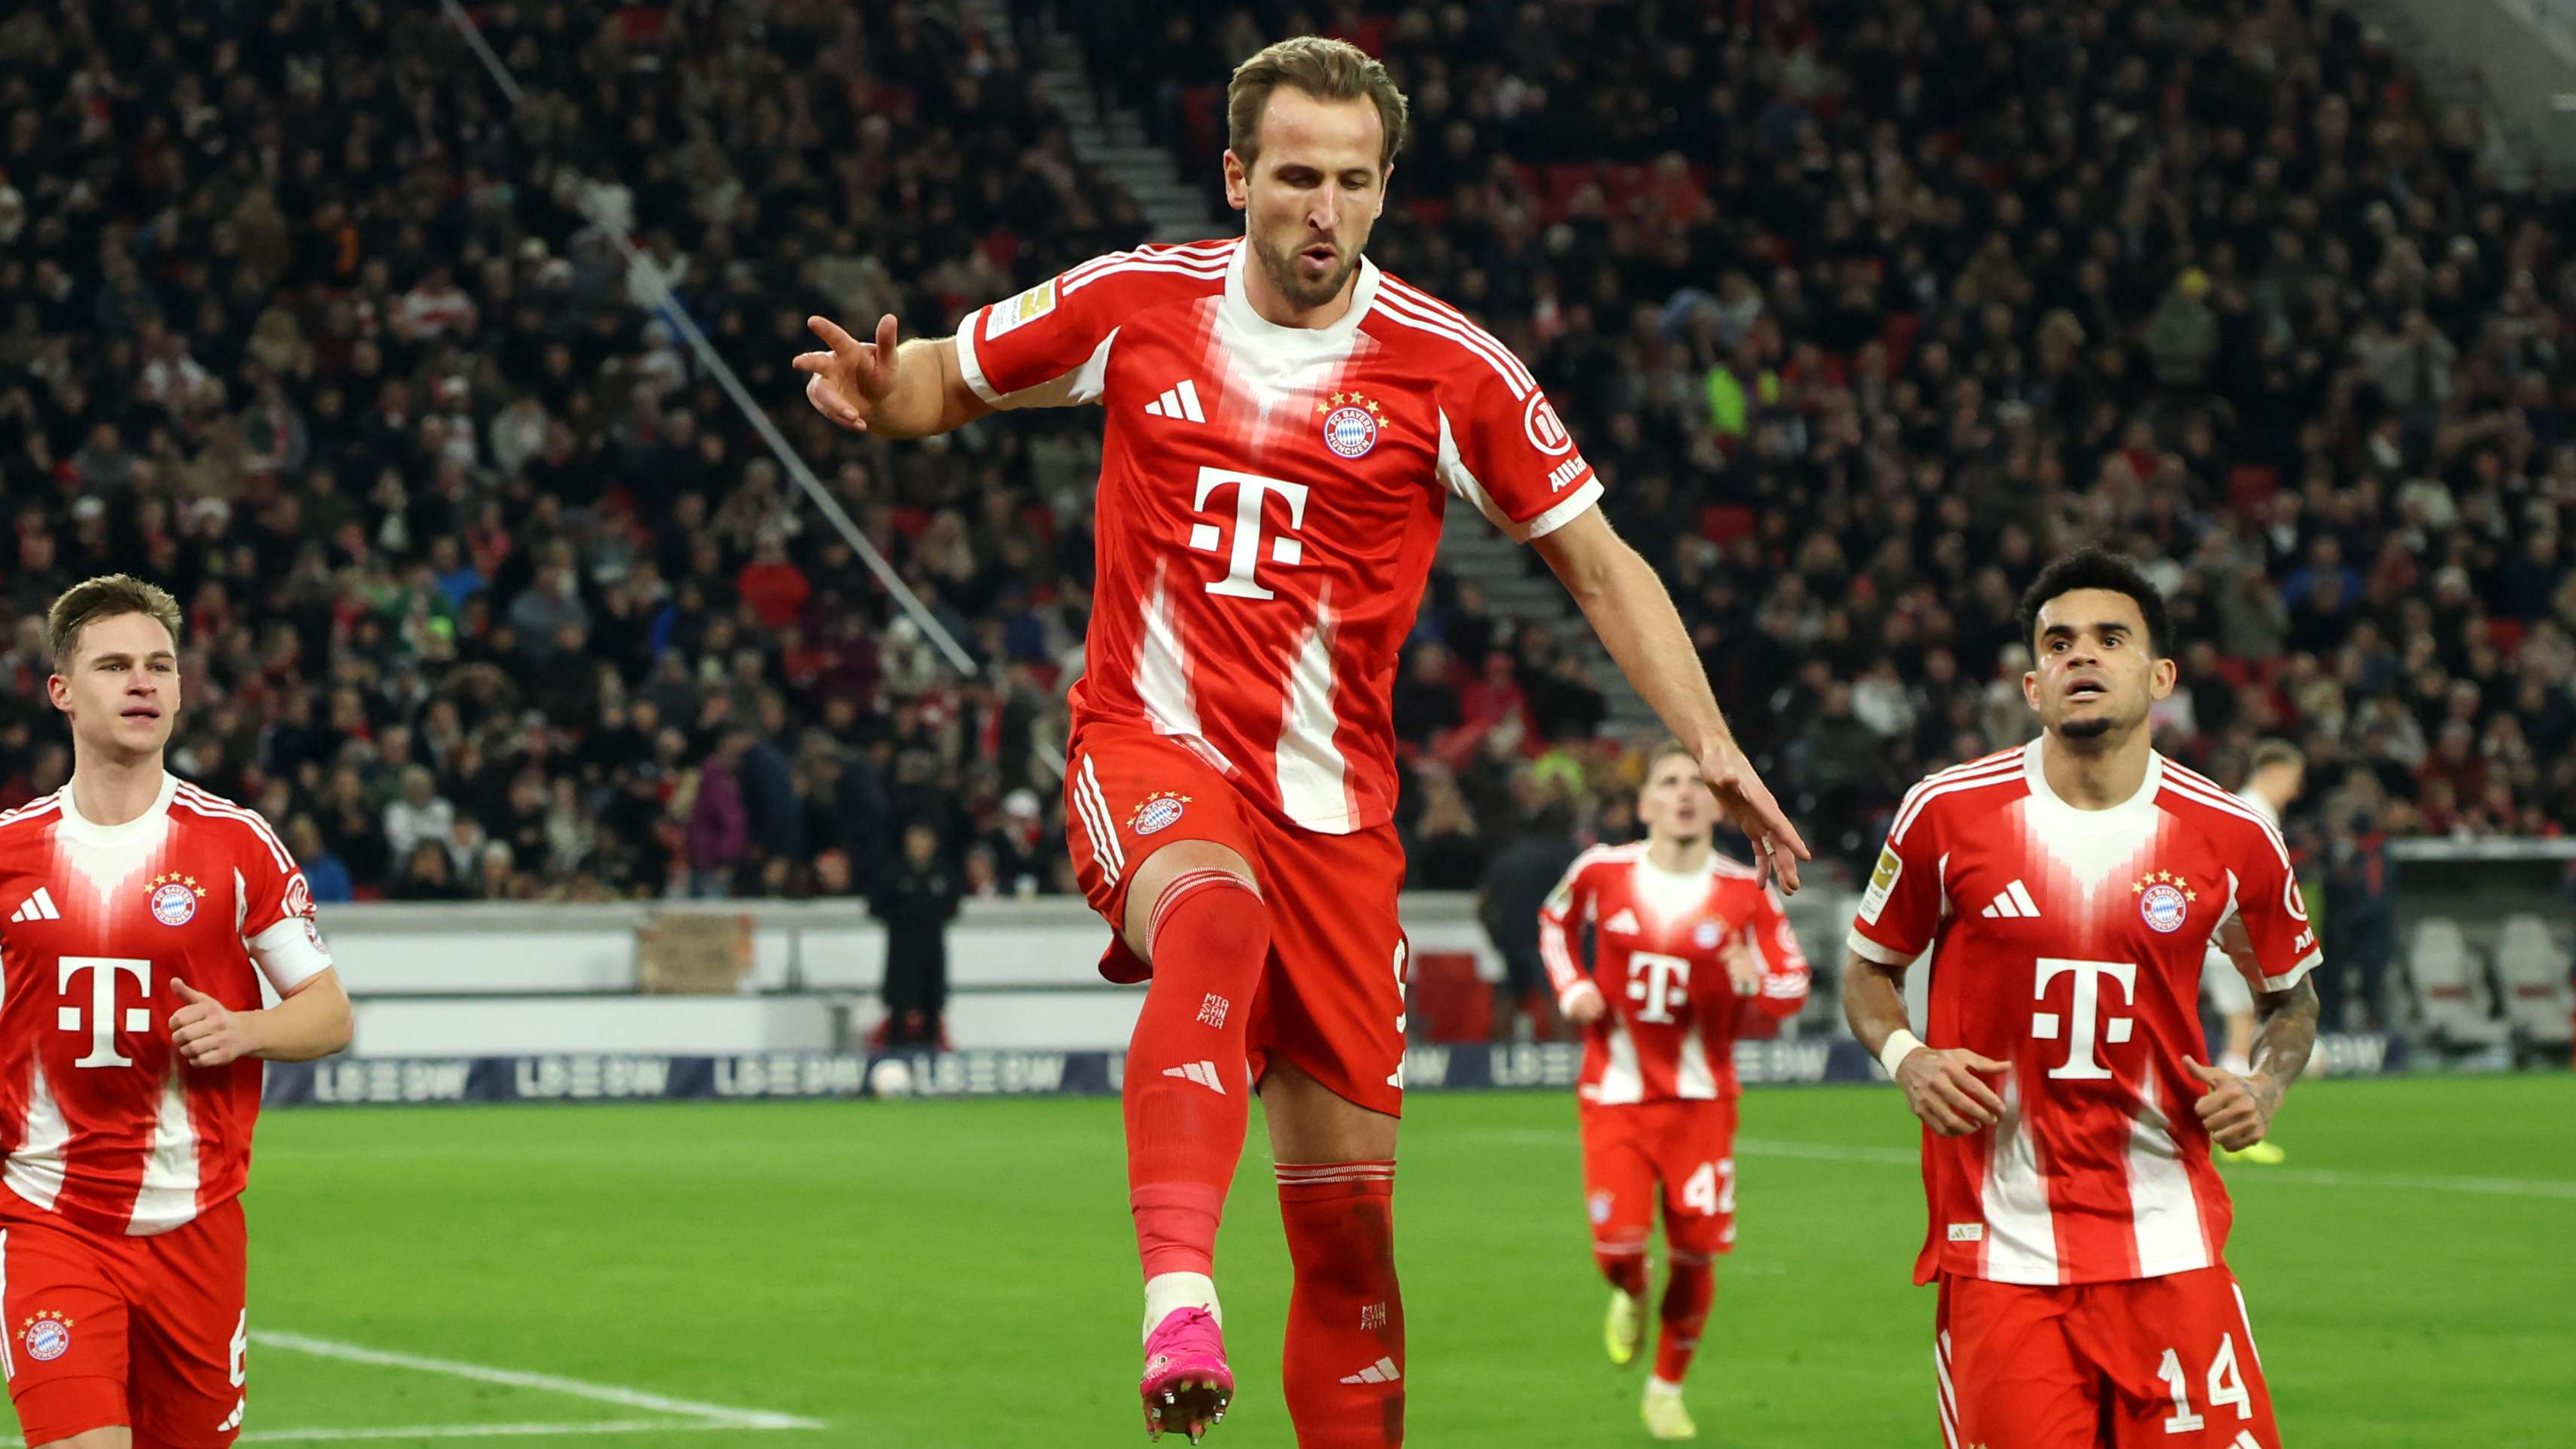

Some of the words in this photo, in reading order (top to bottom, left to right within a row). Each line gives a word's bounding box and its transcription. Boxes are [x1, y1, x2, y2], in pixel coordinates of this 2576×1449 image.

[1330, 415, 1341, 426] FC
[1342, 411, 1373, 433] BAYERN
[1548, 454, 1588, 494] Allia
[1189, 466, 1308, 600] T
[58, 956, 150, 1068] T
[1196, 1011, 1224, 1029] MIA
[1201, 1003, 1226, 1021] SAN
[1204, 992, 1229, 1011] MIA
[2031, 958, 2137, 1079] T
[1682, 1158, 1736, 1216] 42
[2158, 1332, 2252, 1434] 14
